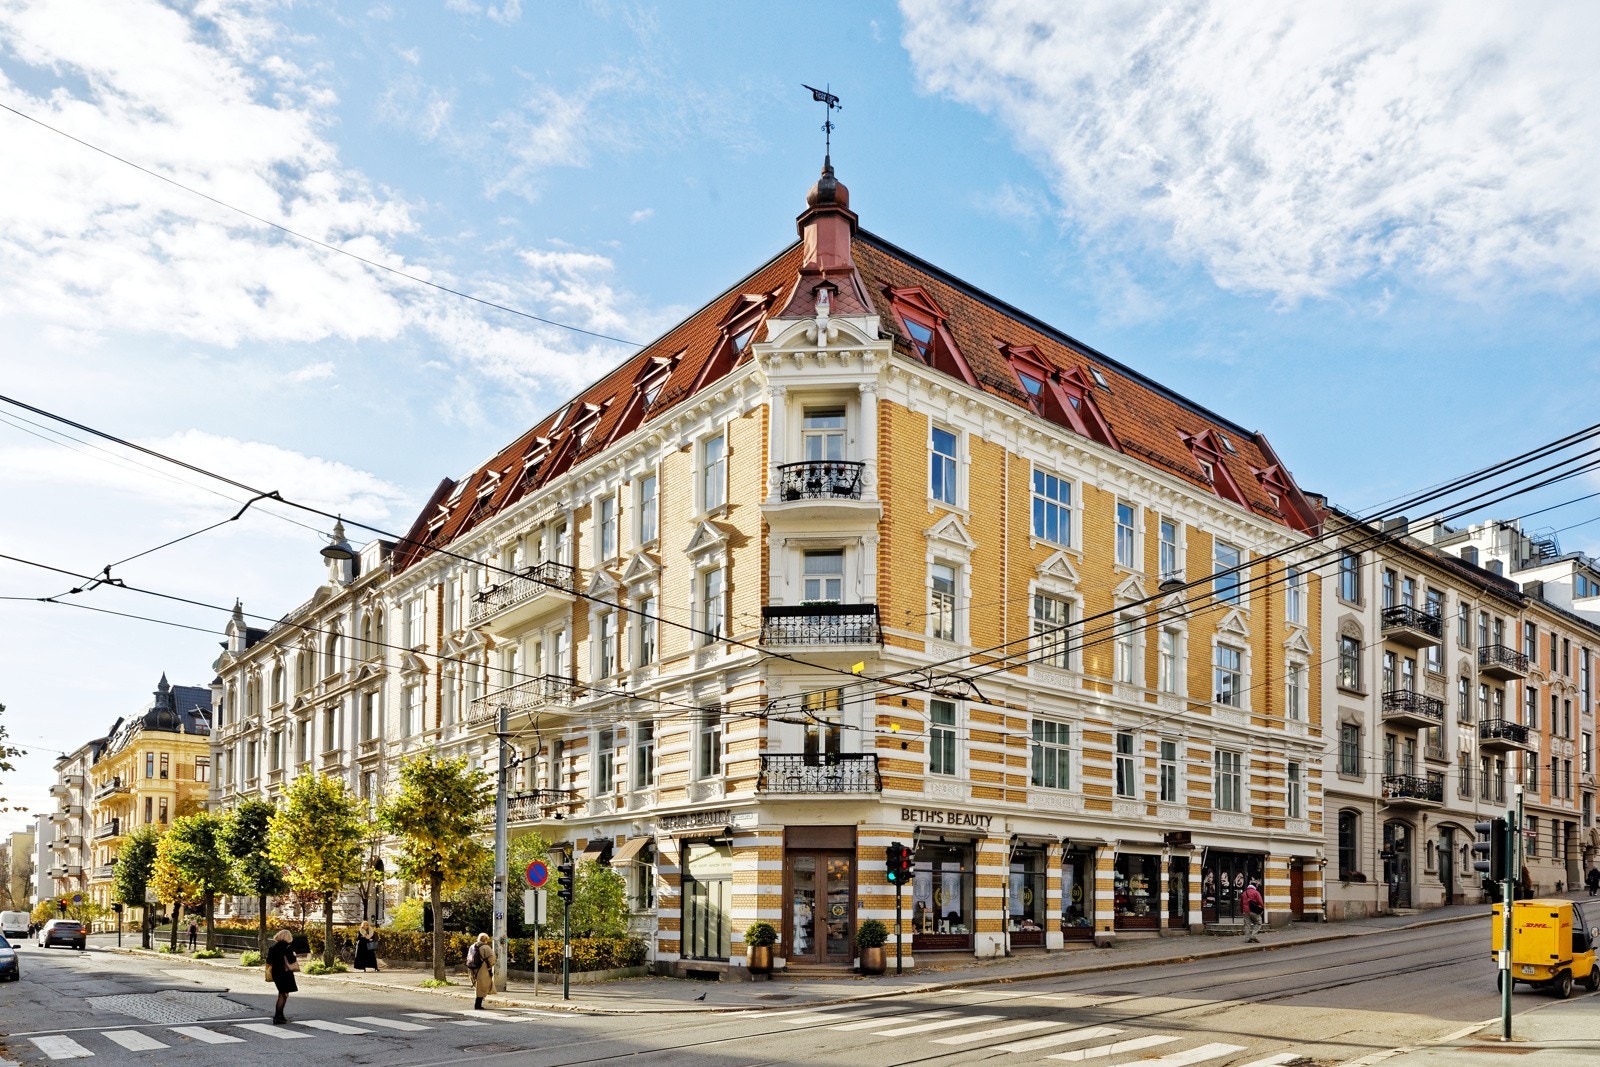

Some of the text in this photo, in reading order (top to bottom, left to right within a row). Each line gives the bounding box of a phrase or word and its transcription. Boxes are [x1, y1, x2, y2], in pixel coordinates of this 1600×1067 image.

[689, 810, 731, 825] BEAUTY
[901, 808, 993, 827] BETH'S BEAUTY
